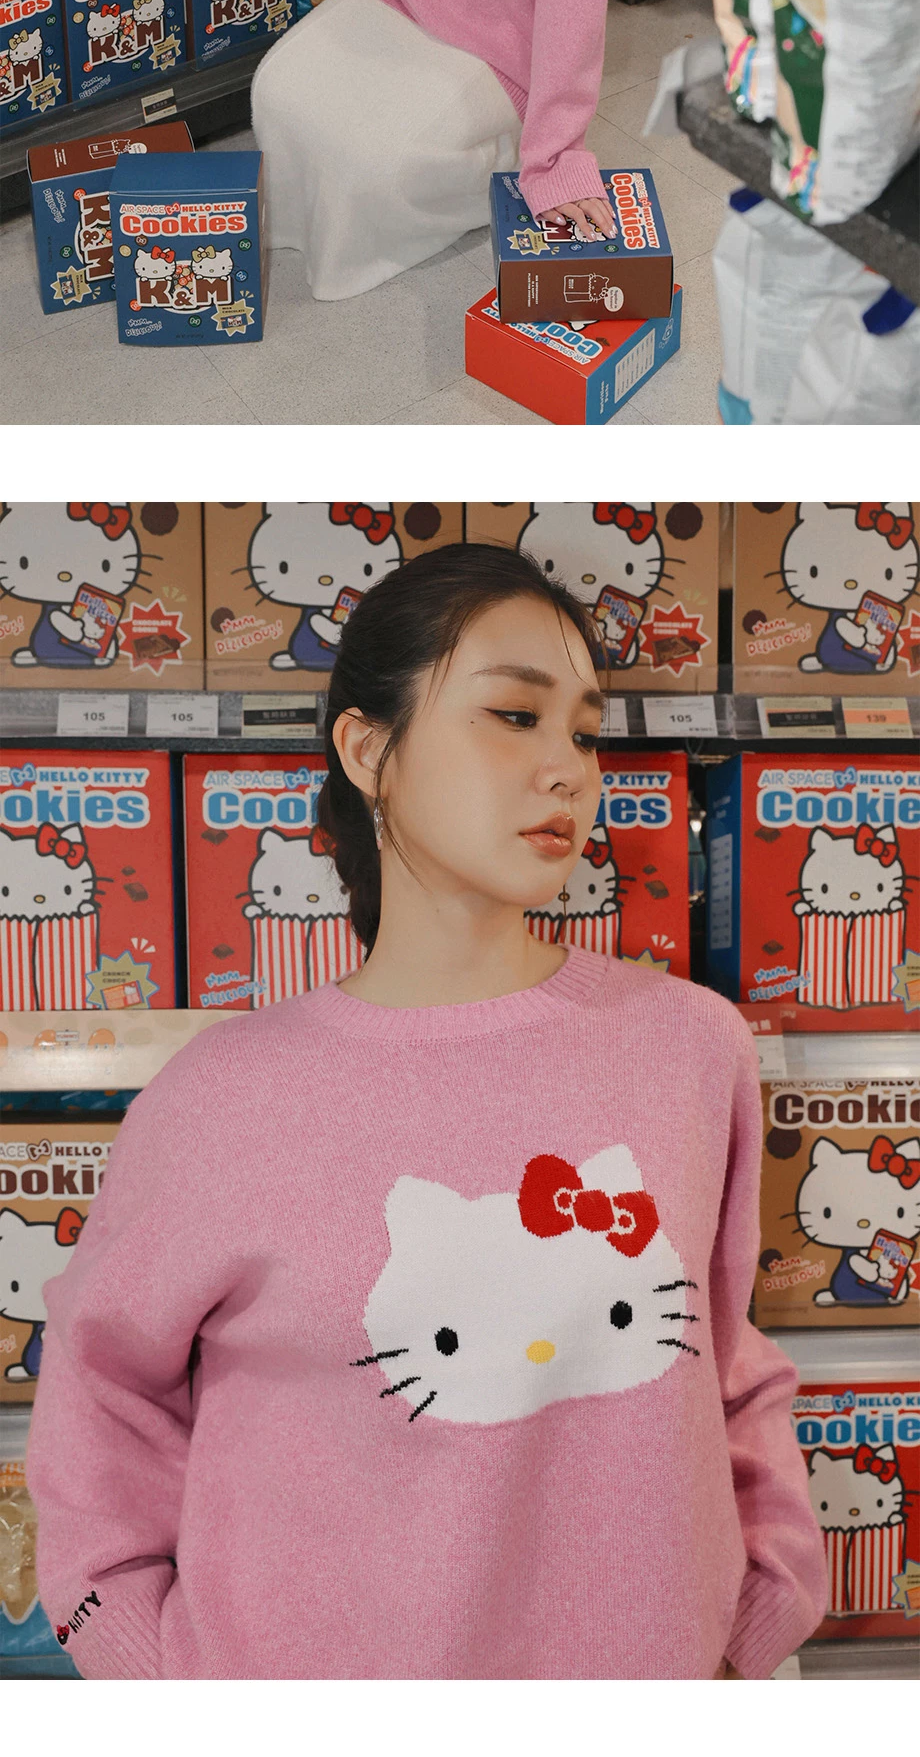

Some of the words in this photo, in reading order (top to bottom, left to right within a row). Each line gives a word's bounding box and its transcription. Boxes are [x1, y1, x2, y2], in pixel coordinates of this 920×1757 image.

[90, 21, 162, 64] K&M
[120, 205, 135, 213] AIR
[136, 205, 165, 214] SPACE
[182, 204, 210, 212] HELLO
[214, 202, 244, 211] KITTY
[613, 174, 643, 249] Cookies
[122, 215, 245, 234] Cookies
[139, 279, 229, 306] K&M
[83, 712, 105, 722] 105
[171, 712, 193, 723] 105
[669, 714, 692, 723] 105
[39, 771, 89, 782] HELLO
[94, 771, 146, 782] KITTY
[206, 773, 227, 785] AIR
[229, 773, 282, 785] SPACE
[761, 773, 784, 785] AIR
[788, 772, 832, 785] SPACE
[860, 774, 901, 786] HELLO
[762, 791, 920, 824] Cookie
[55, 1146, 102, 1156] HELLO
[68, 1591, 101, 1634] KITTY
